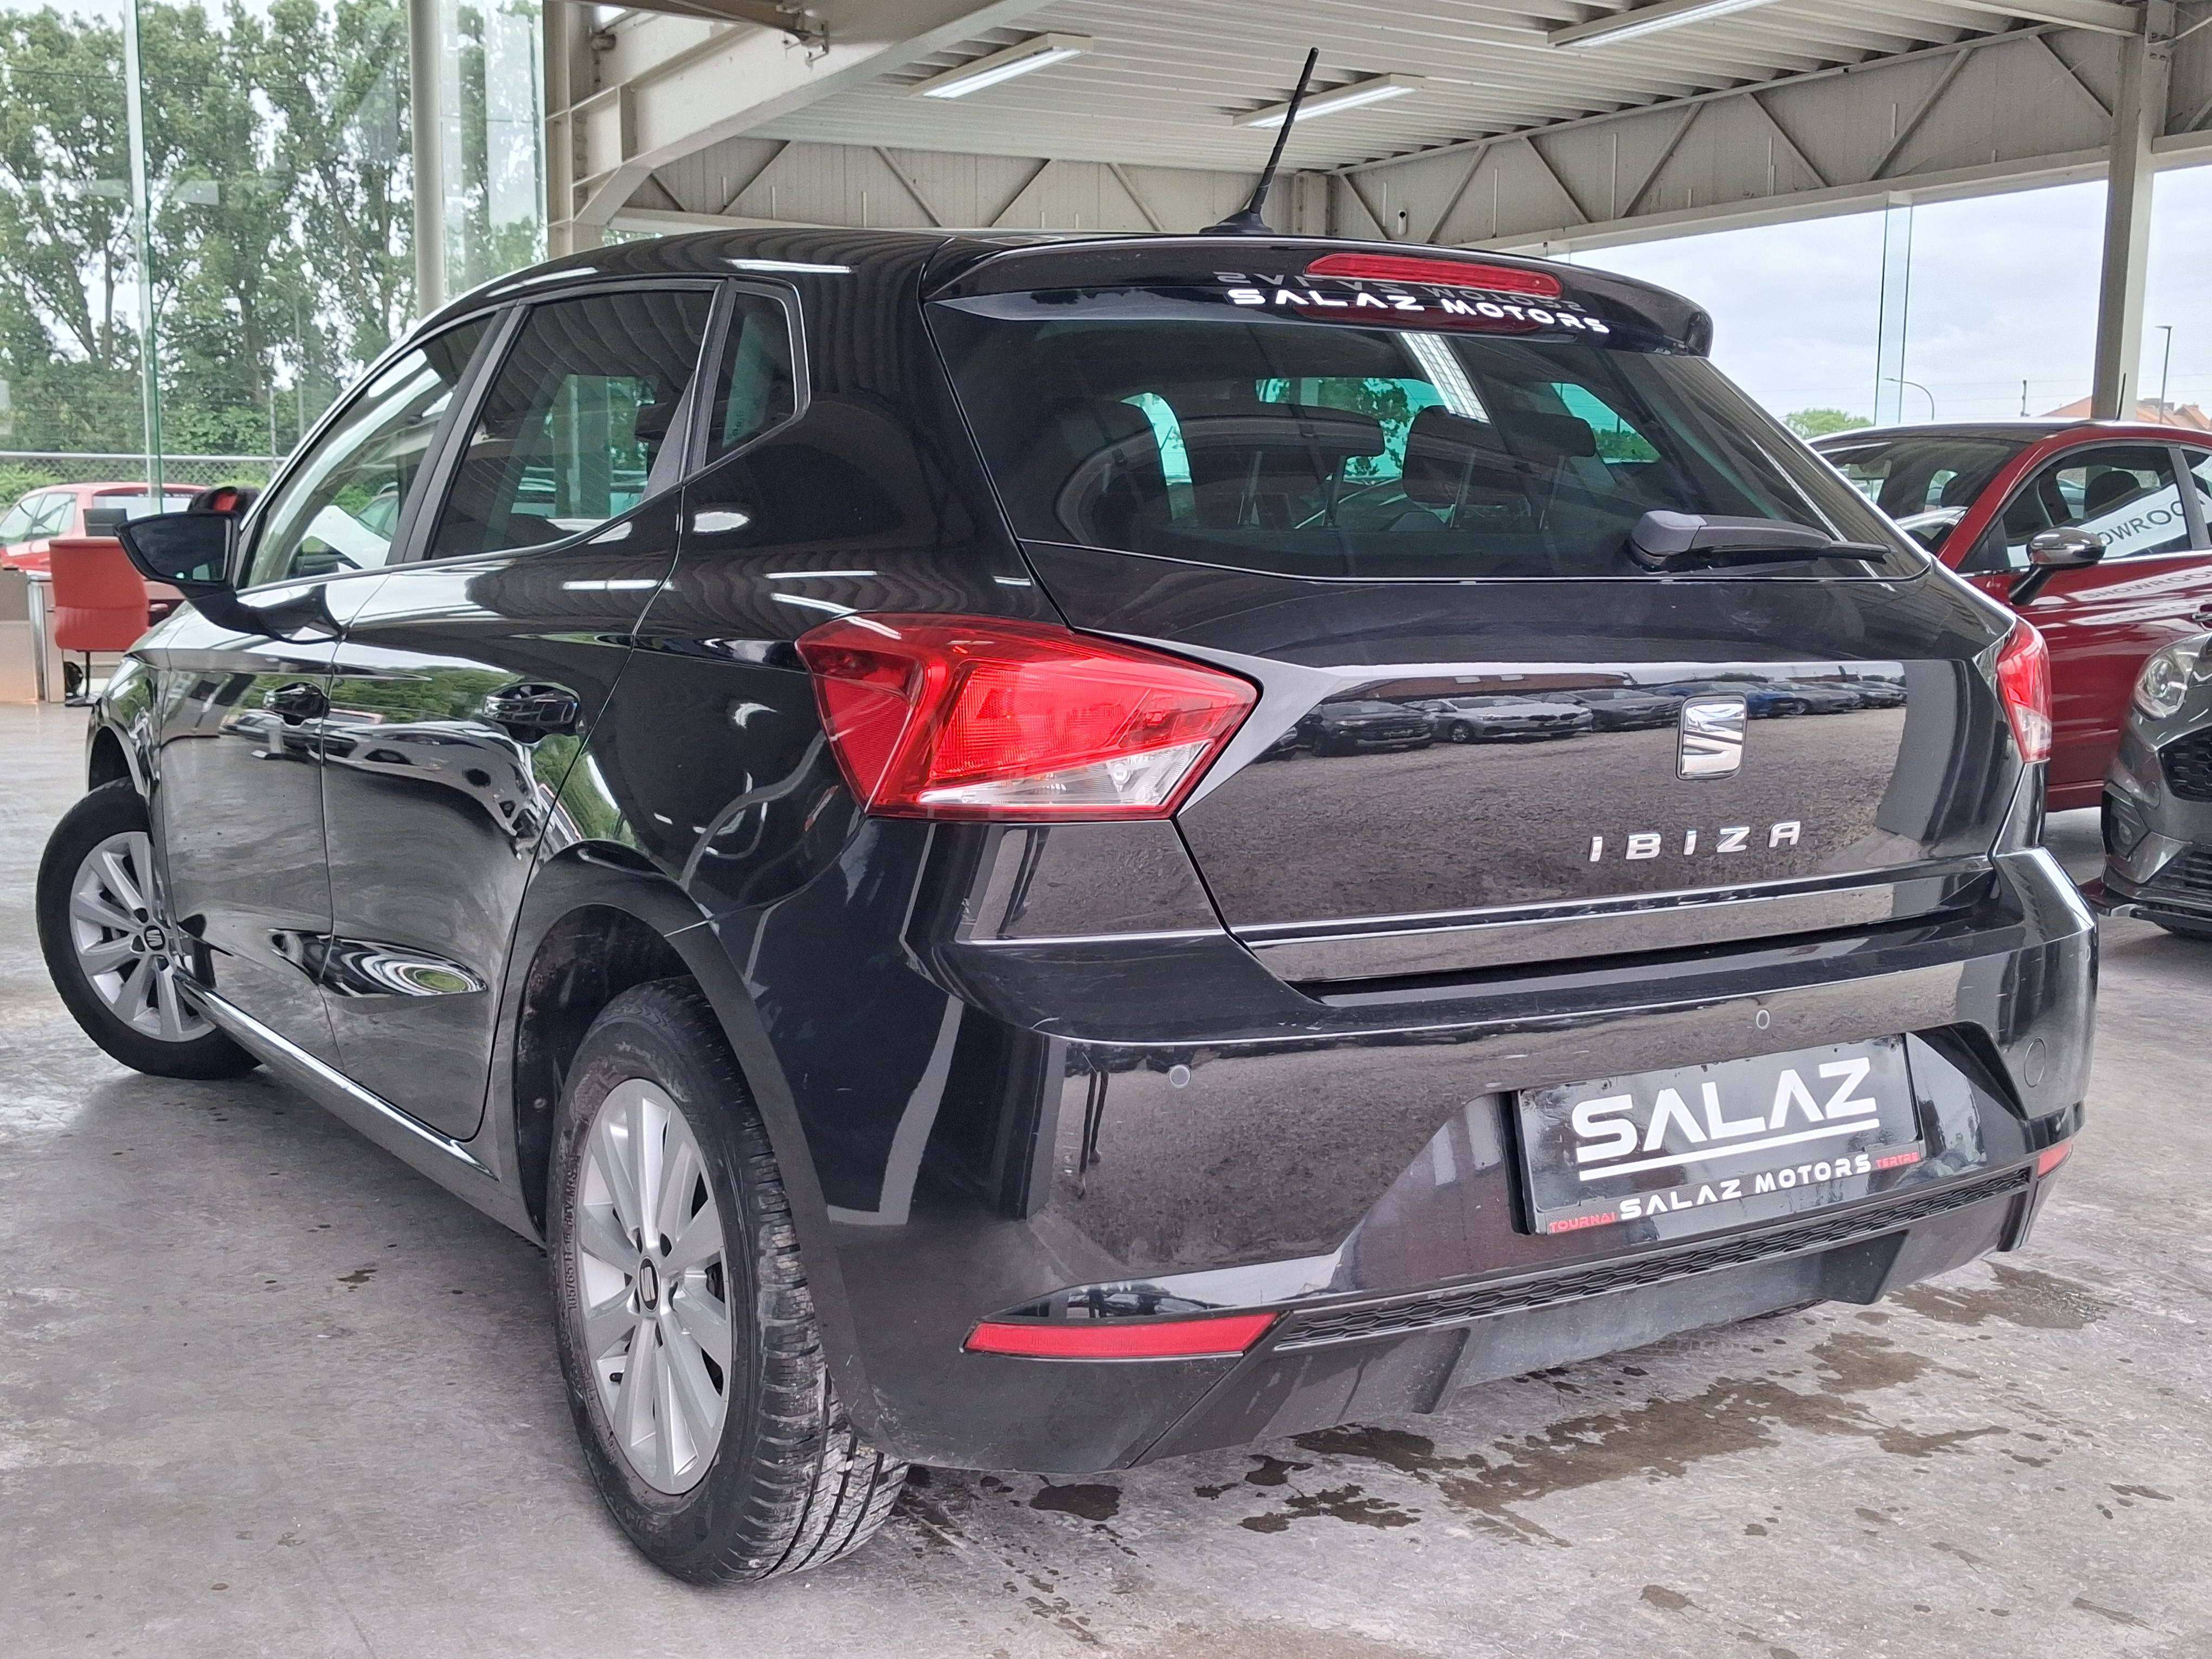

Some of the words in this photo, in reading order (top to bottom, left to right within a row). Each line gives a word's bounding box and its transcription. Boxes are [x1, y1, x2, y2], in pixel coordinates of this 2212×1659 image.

[1227, 288, 1425, 311] SALAZ
[1441, 298, 1610, 333] MOTORS
[2082, 571, 2212, 599] SHOWROO
[1589, 821, 1801, 862] IBIZA
[1572, 1057, 1877, 1162] SALAZ
[1549, 1211, 1617, 1233] TOURNAI
[1619, 1179, 1742, 1220] SALAZ
[1755, 1153, 1872, 1193] MOTORS
[1876, 1152, 1919, 1169] TERTRE
